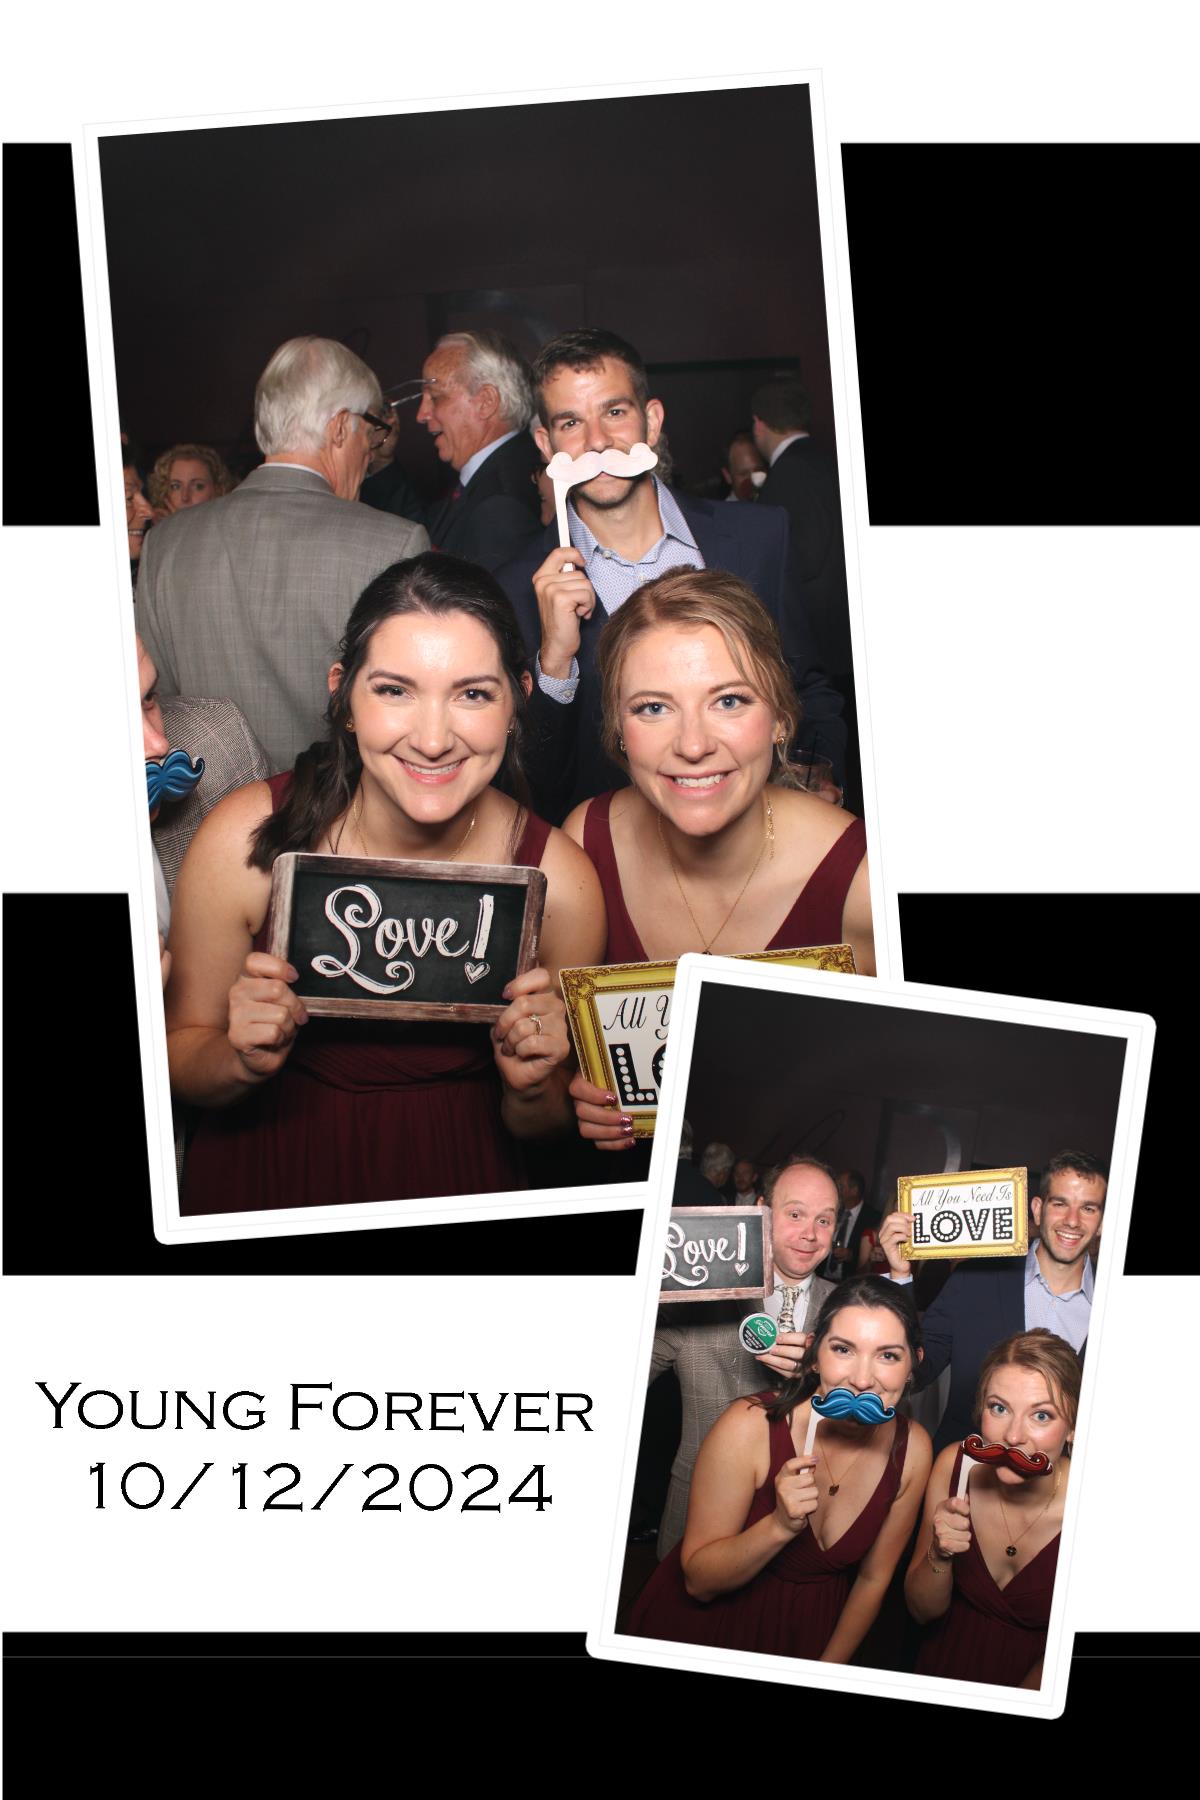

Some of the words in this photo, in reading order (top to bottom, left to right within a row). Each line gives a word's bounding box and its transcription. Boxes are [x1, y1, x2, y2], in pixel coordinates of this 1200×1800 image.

[311, 884, 495, 995] Love!
[603, 996, 647, 1031] All
[912, 1189, 935, 1207] All
[935, 1188, 961, 1211] You
[964, 1185, 996, 1203] Need
[996, 1184, 1012, 1200] Is
[913, 1207, 1013, 1244] LOVE
[661, 1222, 747, 1287] Love!
